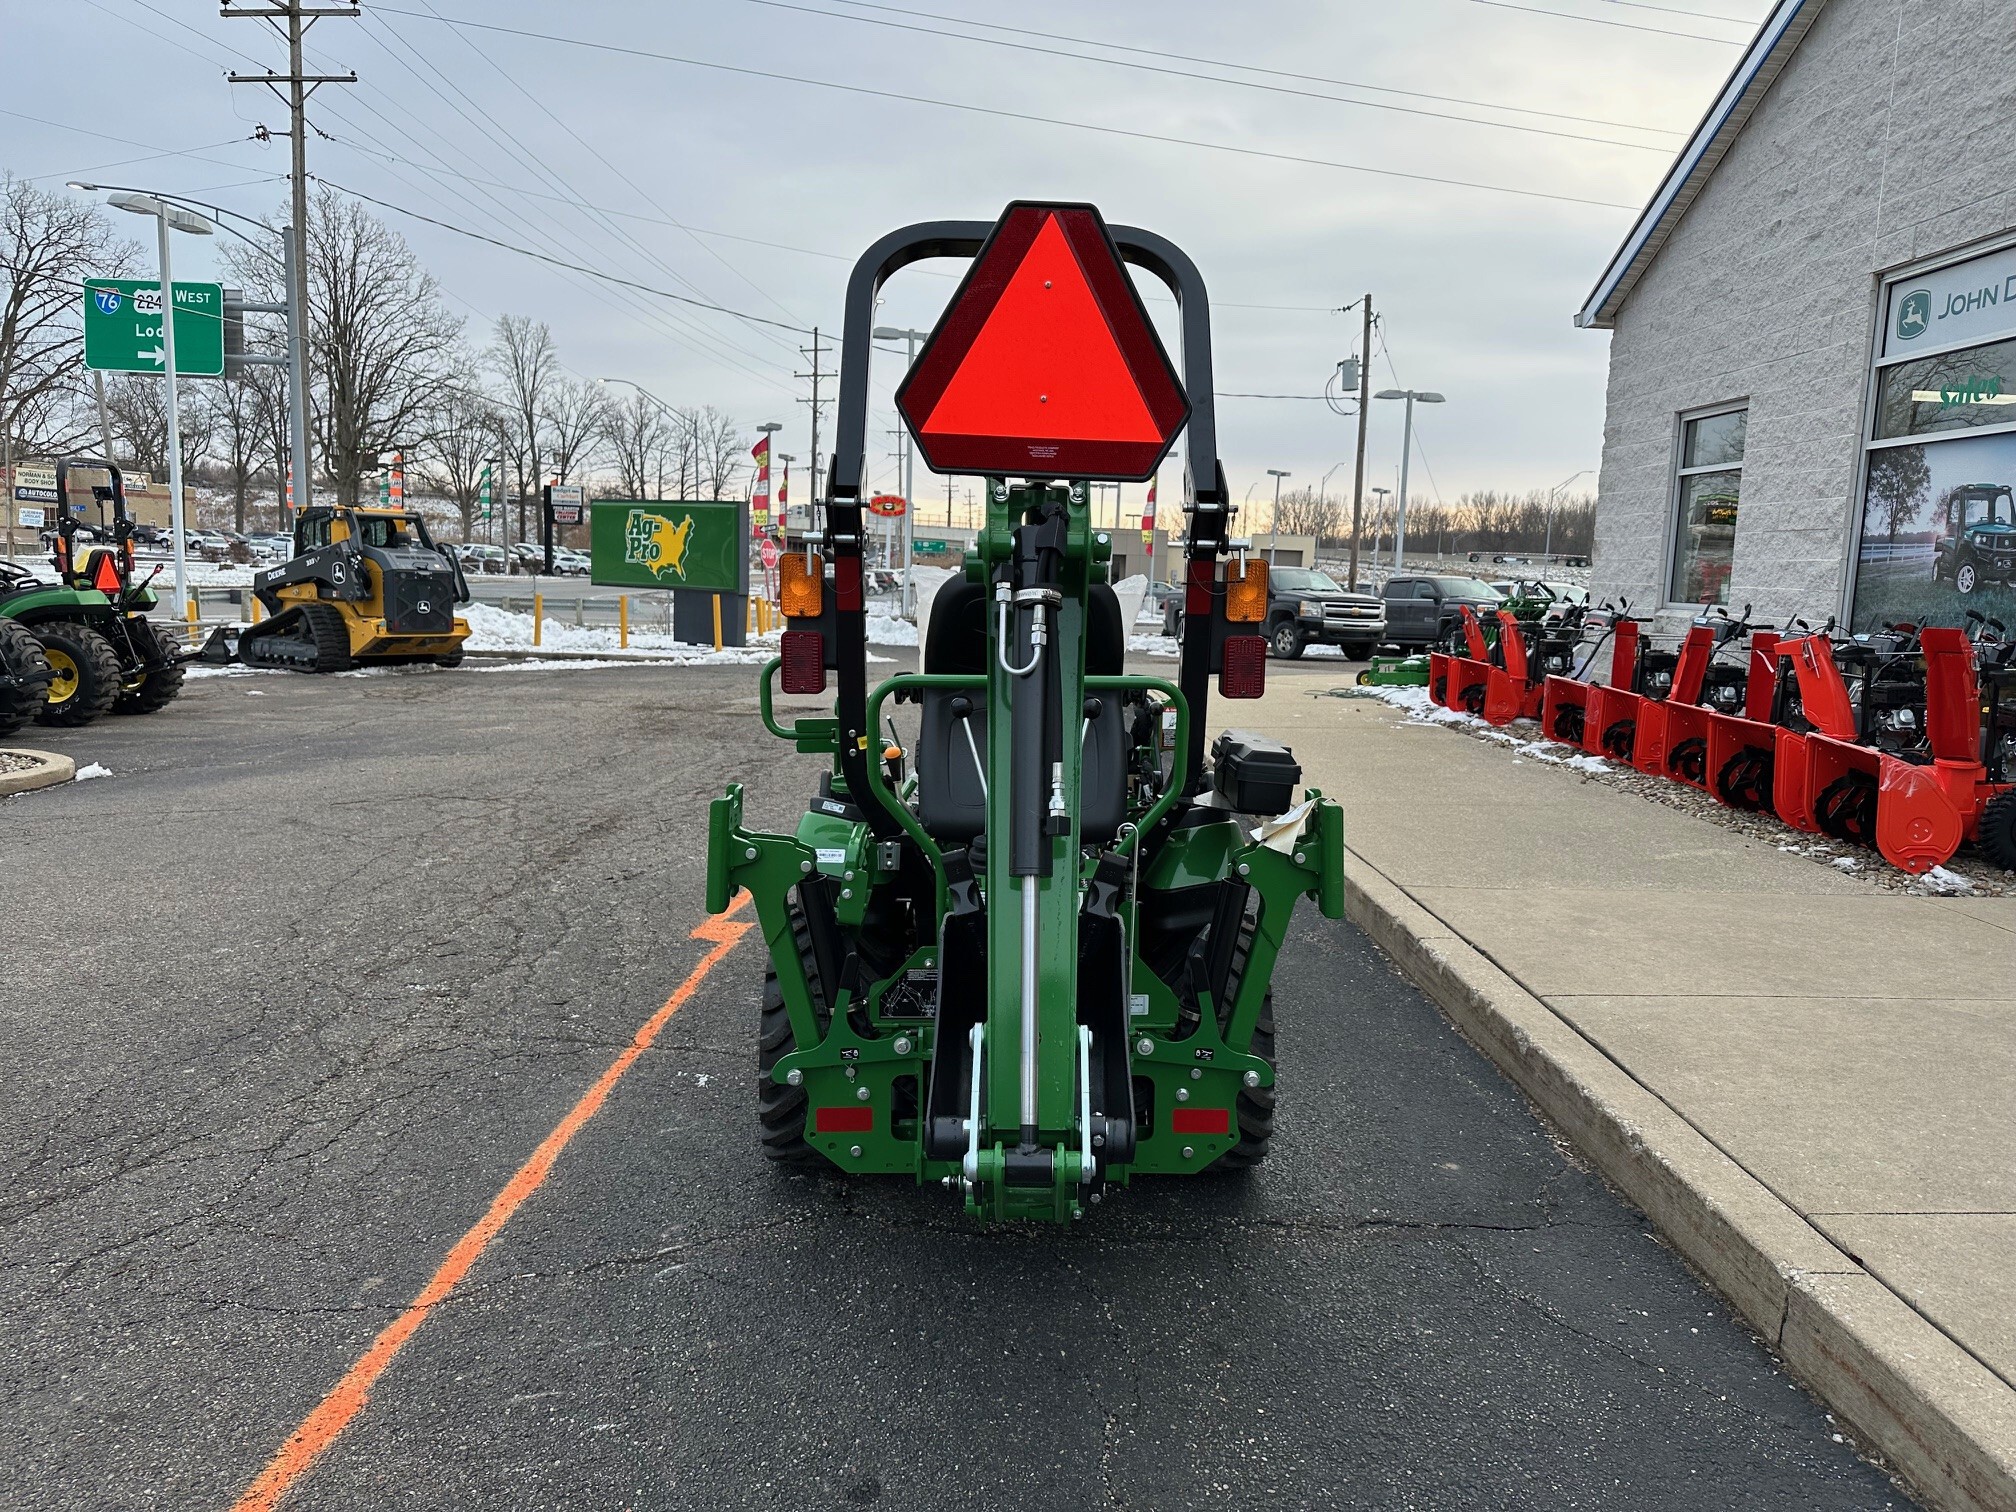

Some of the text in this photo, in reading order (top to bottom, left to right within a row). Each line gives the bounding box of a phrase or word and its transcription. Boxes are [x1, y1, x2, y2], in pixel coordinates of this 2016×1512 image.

[98, 294, 118, 309] 76
[137, 294, 163, 309] 224
[1938, 284, 1999, 320] JOHN
[135, 323, 164, 338] Lod
[28, 489, 57, 497] AUTOCOLO
[628, 510, 662, 543] Ag-
[627, 537, 662, 563] Pro
[762, 548, 776, 559] STOP
